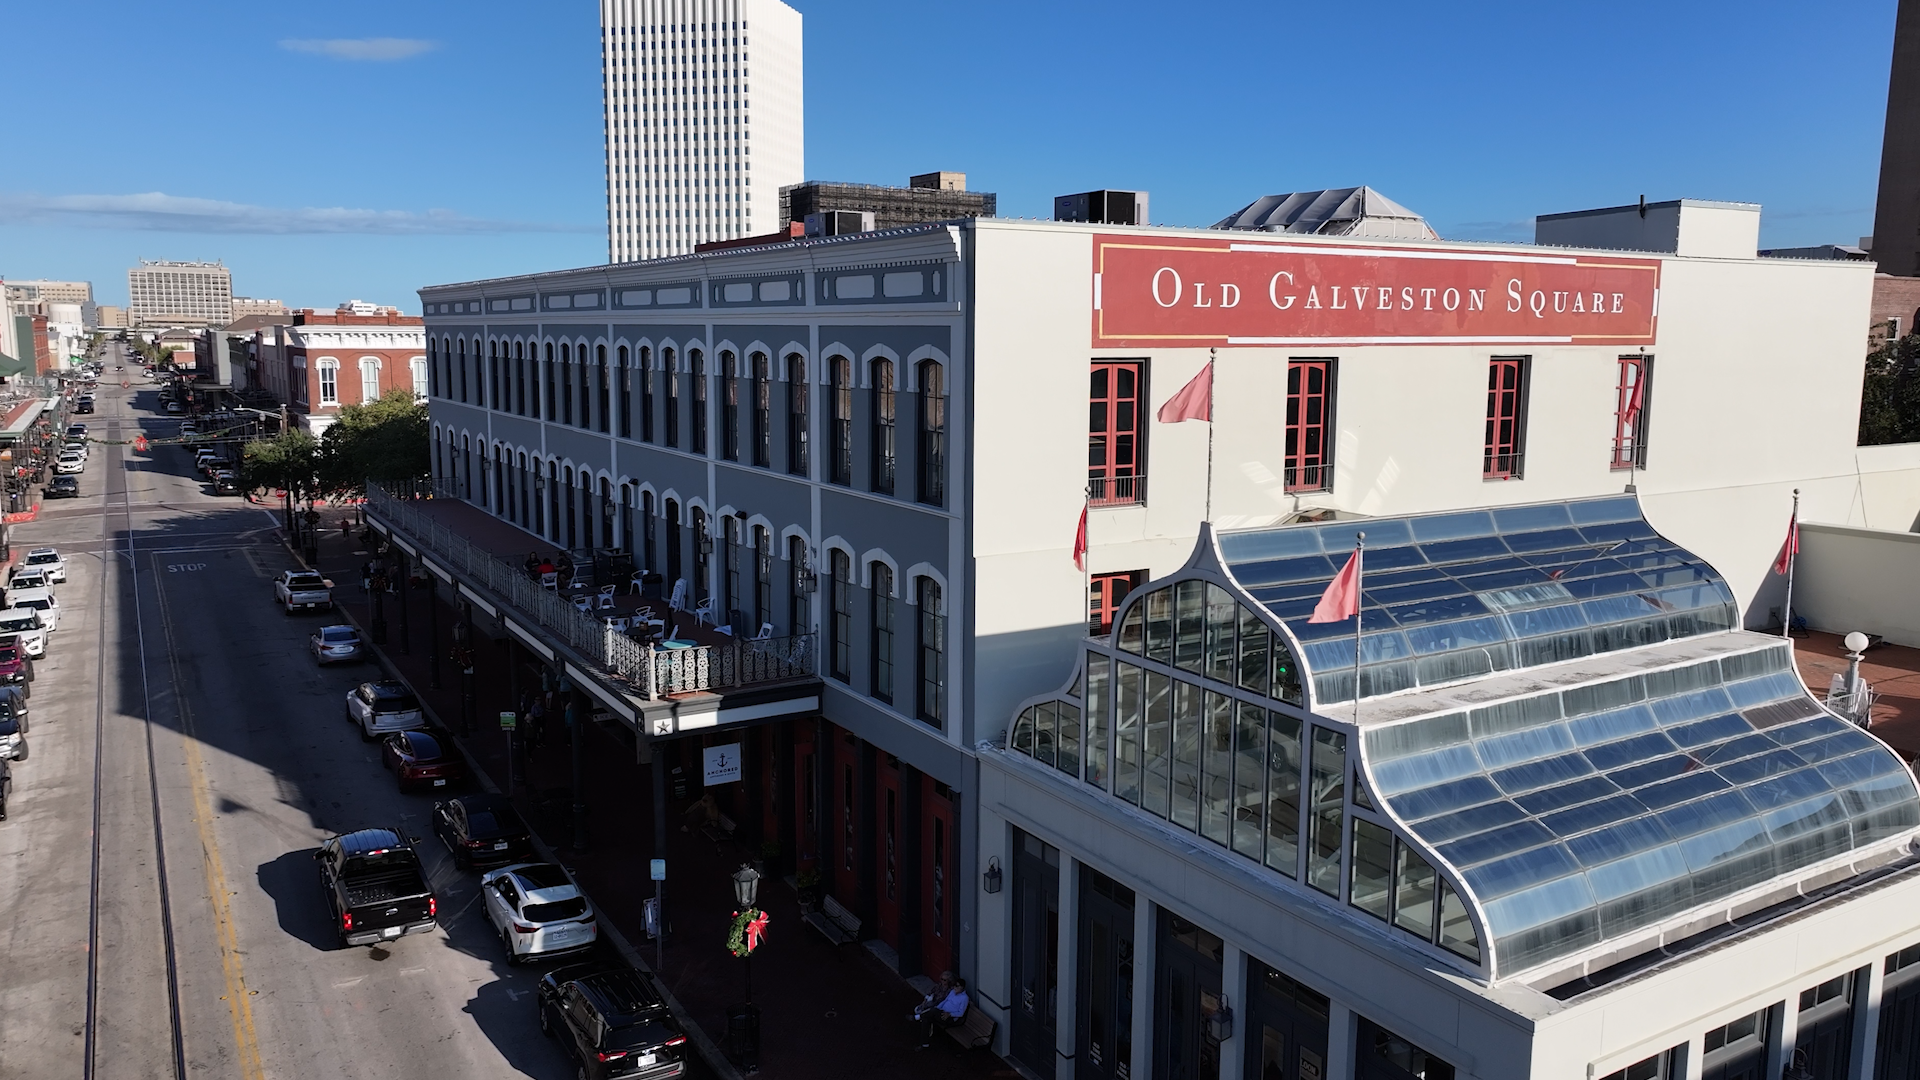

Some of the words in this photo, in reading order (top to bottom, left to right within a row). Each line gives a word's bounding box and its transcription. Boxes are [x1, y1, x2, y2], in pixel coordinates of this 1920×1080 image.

[1151, 266, 1241, 308] OLD
[1269, 271, 1487, 311] GALVESTON
[1506, 278, 1625, 319] SQUARE
[166, 562, 207, 573] STOP
[707, 766, 739, 776] ANCHORED
